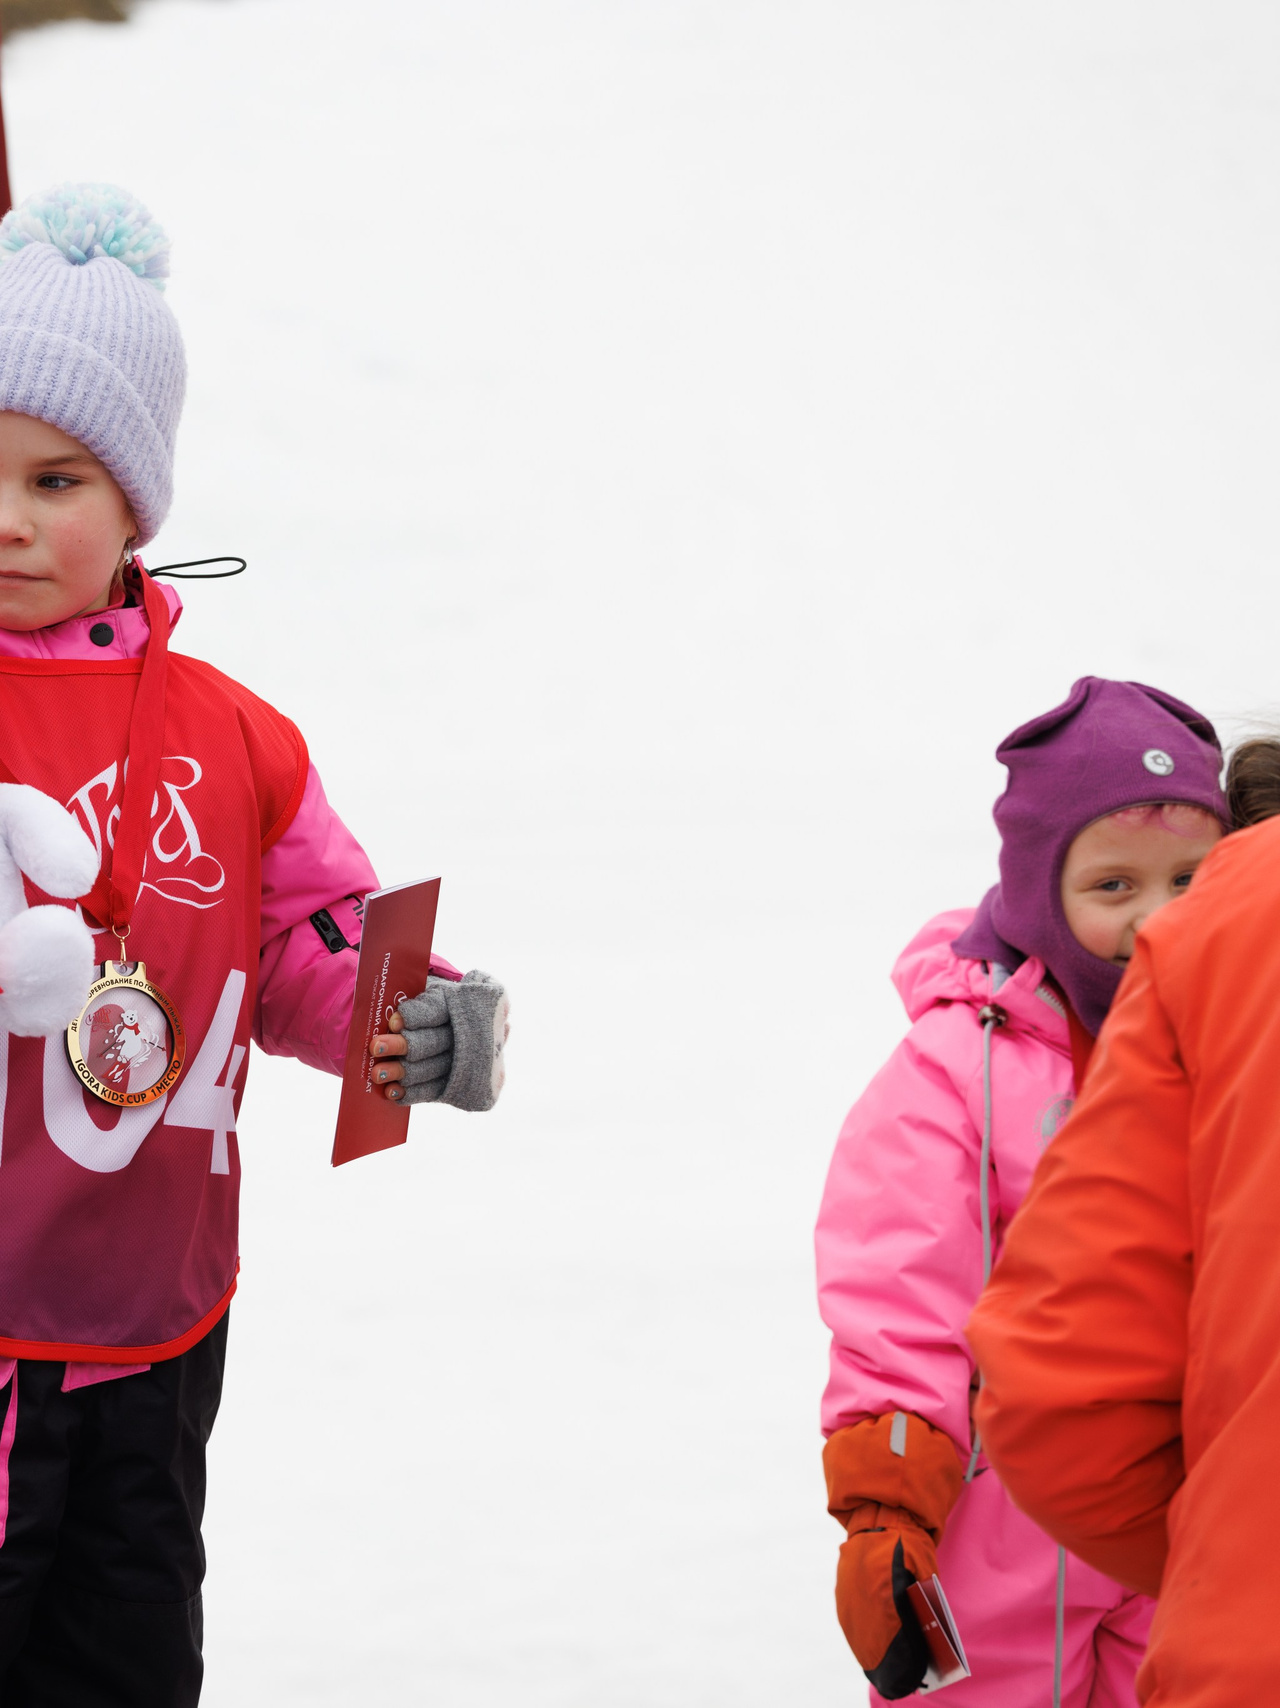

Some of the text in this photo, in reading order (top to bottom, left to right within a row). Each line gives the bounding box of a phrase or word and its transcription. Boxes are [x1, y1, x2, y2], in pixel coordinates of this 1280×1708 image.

[88, 978, 133, 999] ОРЕВНОВАНИЕ
[133, 979, 144, 988] ПО
[144, 984, 170, 1007] ГОРНЫМ
[374, 952, 391, 1026] ПОДАРОЧНЫЙ
[75, 1058, 147, 1104] IGORA KIDS CUP
[150, 1060, 181, 1097] 1 МЕСТО
